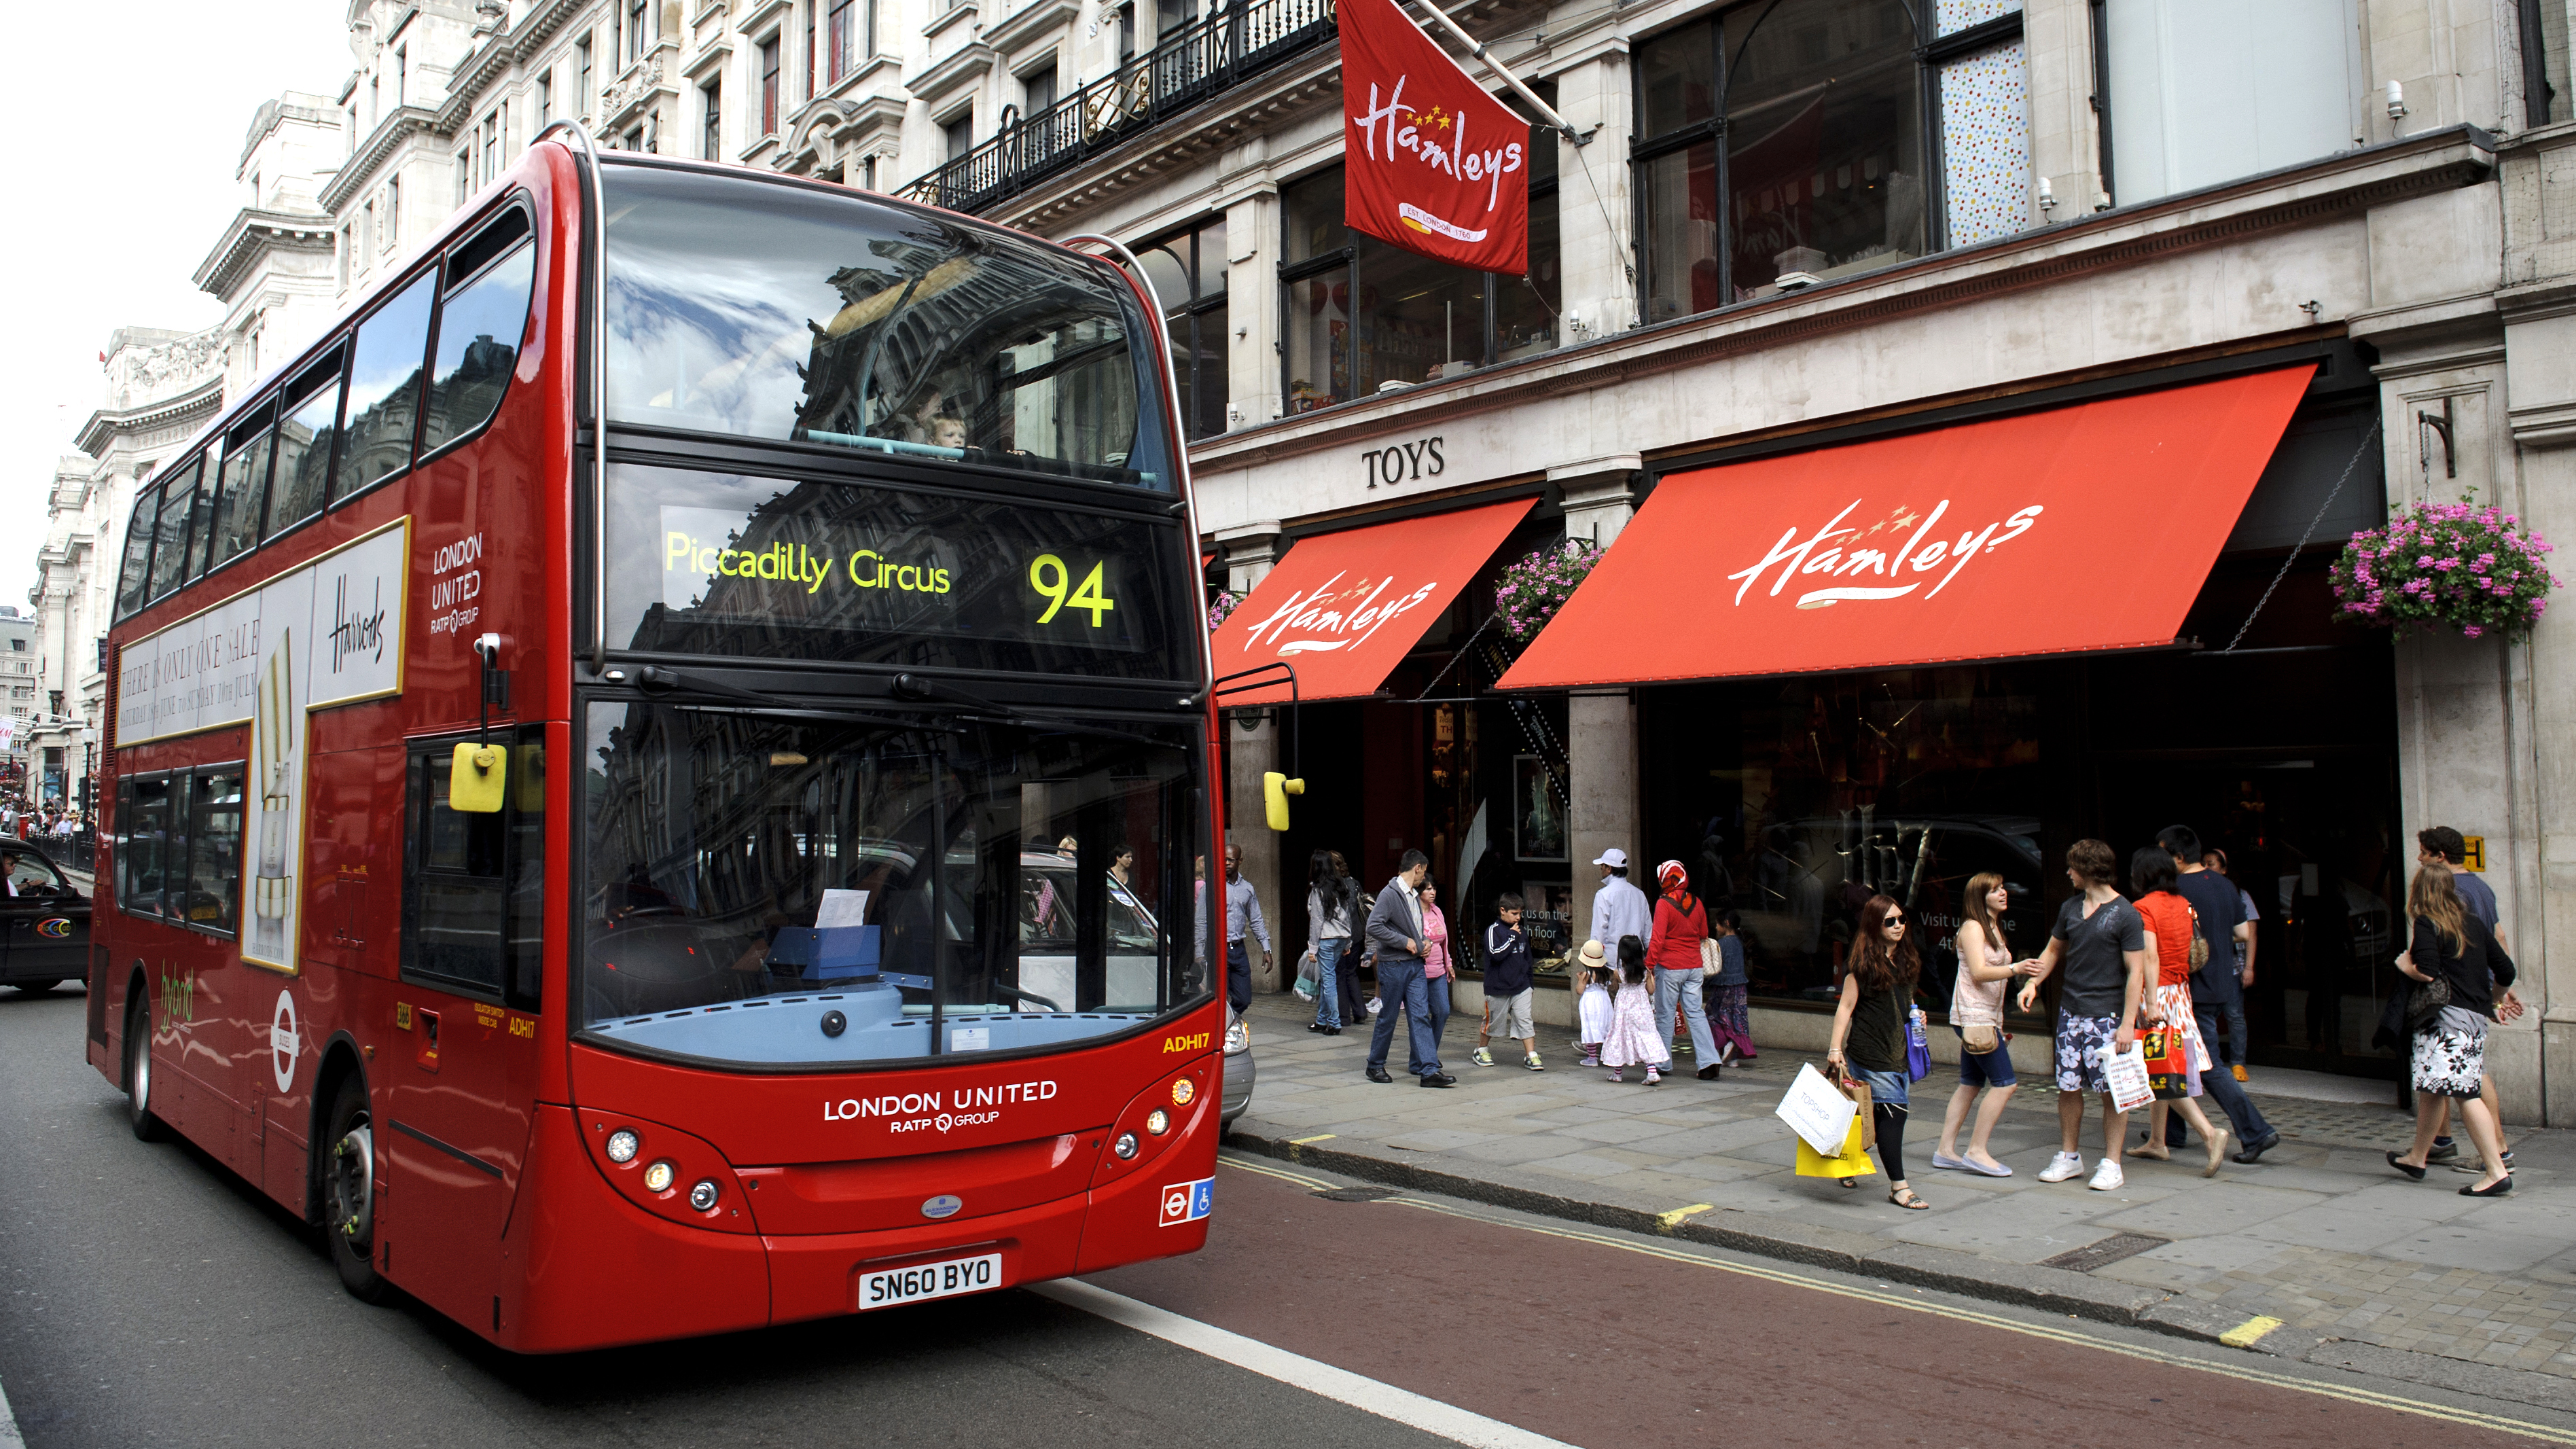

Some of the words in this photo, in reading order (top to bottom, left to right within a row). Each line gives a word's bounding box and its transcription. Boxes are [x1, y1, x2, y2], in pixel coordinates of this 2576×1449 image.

[1355, 74, 1522, 212] Hamleys
[1408, 207, 1420, 219] EST.
[1423, 215, 1451, 233] LONDON
[1455, 230, 1471, 239] 1760
[1361, 435, 1446, 488] TOYS
[433, 532, 482, 575] LONDON
[666, 531, 833, 595] Piccadilly
[848, 549, 950, 594] Circus
[1728, 498, 2043, 606] Hamleys
[432, 570, 480, 610] UNITED
[1029, 554, 1114, 628] 94
[1244, 569, 1437, 652] Hamleys
[329, 573, 384, 674] Harrods
[431, 615, 449, 634] RATP
[458, 607, 479, 627] GROUP
[122, 663, 149, 699] THERE
[152, 657, 160, 689] IS
[164, 645, 194, 684] ONLY
[196, 634, 221, 674] ONE
[227, 619, 260, 664] SALE
[120, 704, 145, 728] SATURDAY
[160, 695, 176, 725] JUNE
[187, 684, 215, 711] SUNDAY
[234, 672, 257, 707] JULY
[1526, 910, 1537, 919] us
[1539, 910, 1550, 920] on
[1553, 908, 1569, 920] the
[1535, 925, 1556, 939] floor
[1920, 911, 1948, 927] Visit
[1952, 916, 1961, 928] u
[1939, 935, 1954, 950] 4t
[509, 1016, 535, 1039] ADH17
[1162, 1032, 1210, 1054] ADH17
[824, 1092, 941, 1121] LONDON
[954, 1080, 1057, 1109] UNITED
[1801, 1091, 1829, 1121] TOPSHOP
[890, 1118, 931, 1134] RATP
[954, 1111, 999, 1127] GROUP
[870, 1268, 935, 1302] SN60
[944, 1259, 990, 1290] BYO
